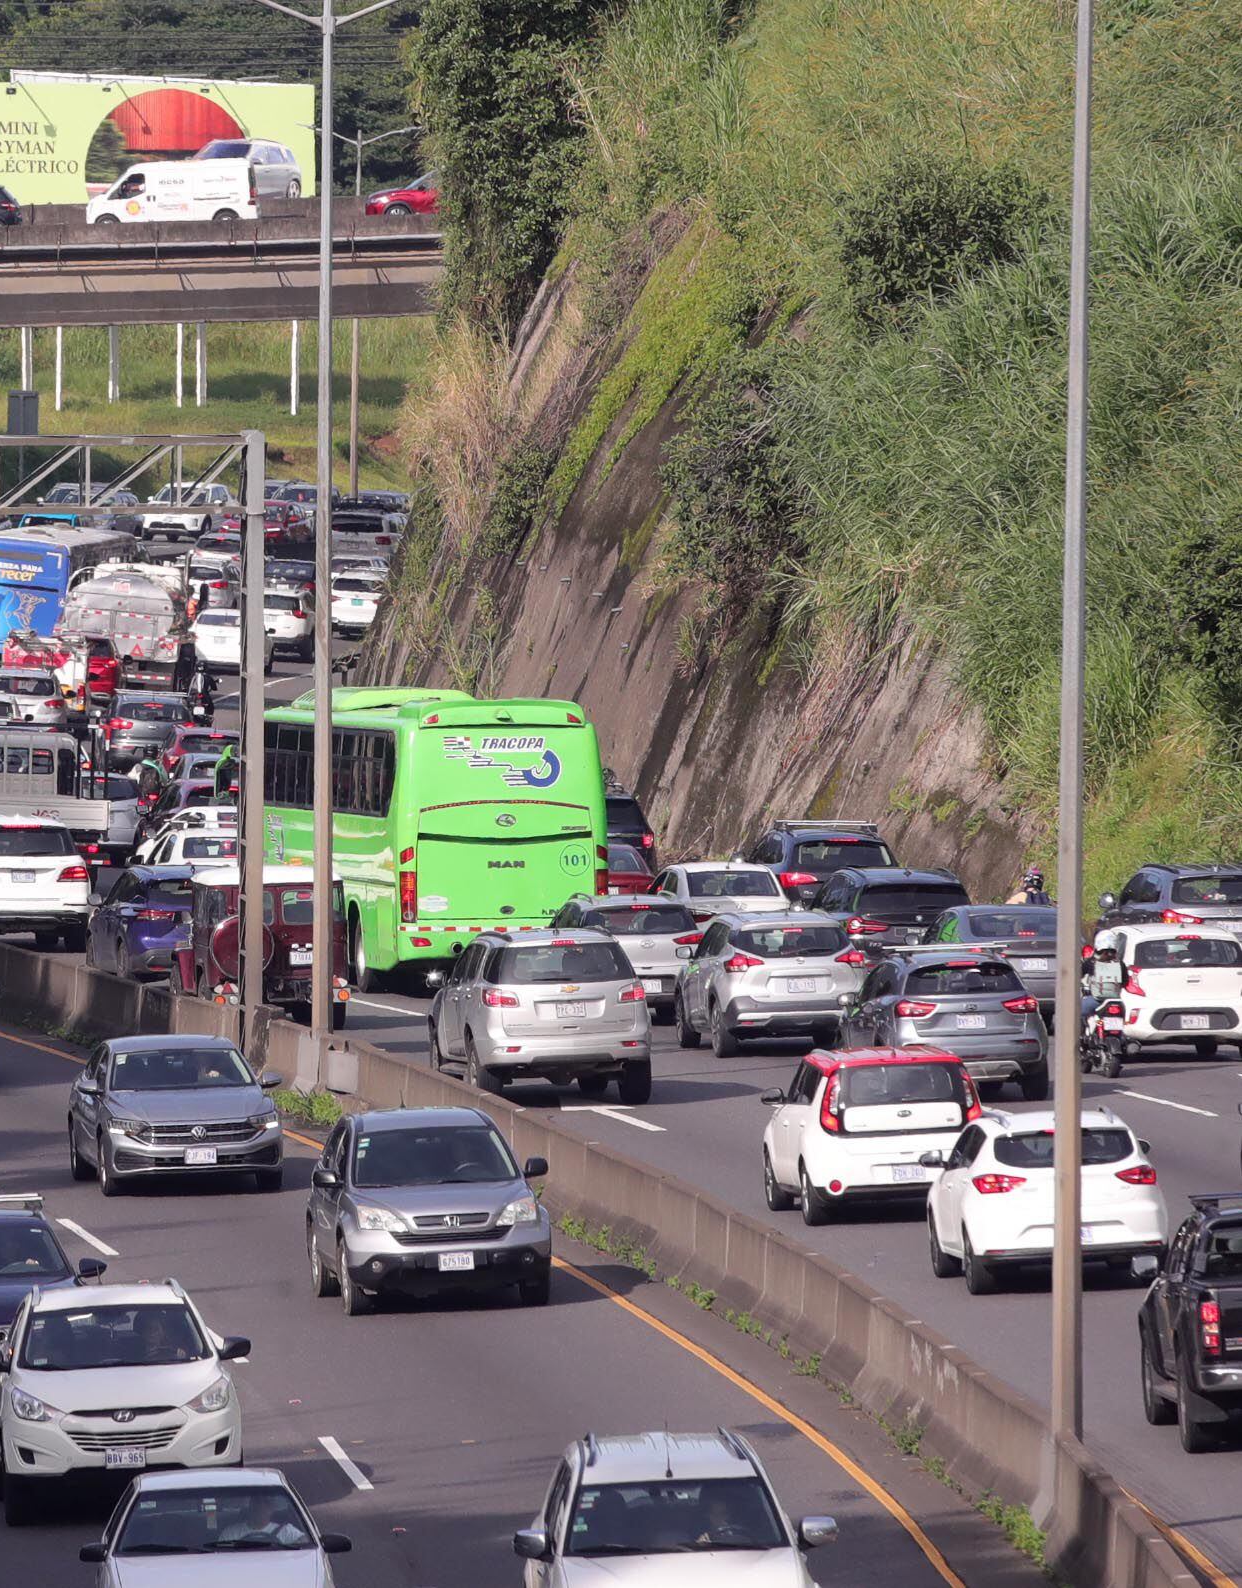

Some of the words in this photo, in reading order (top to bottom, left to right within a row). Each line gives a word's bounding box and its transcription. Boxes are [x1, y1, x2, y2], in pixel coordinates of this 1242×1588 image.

[21, 563, 44, 573] PARA
[481, 737, 545, 750] TRACOPA
[563, 854, 587, 867] 101
